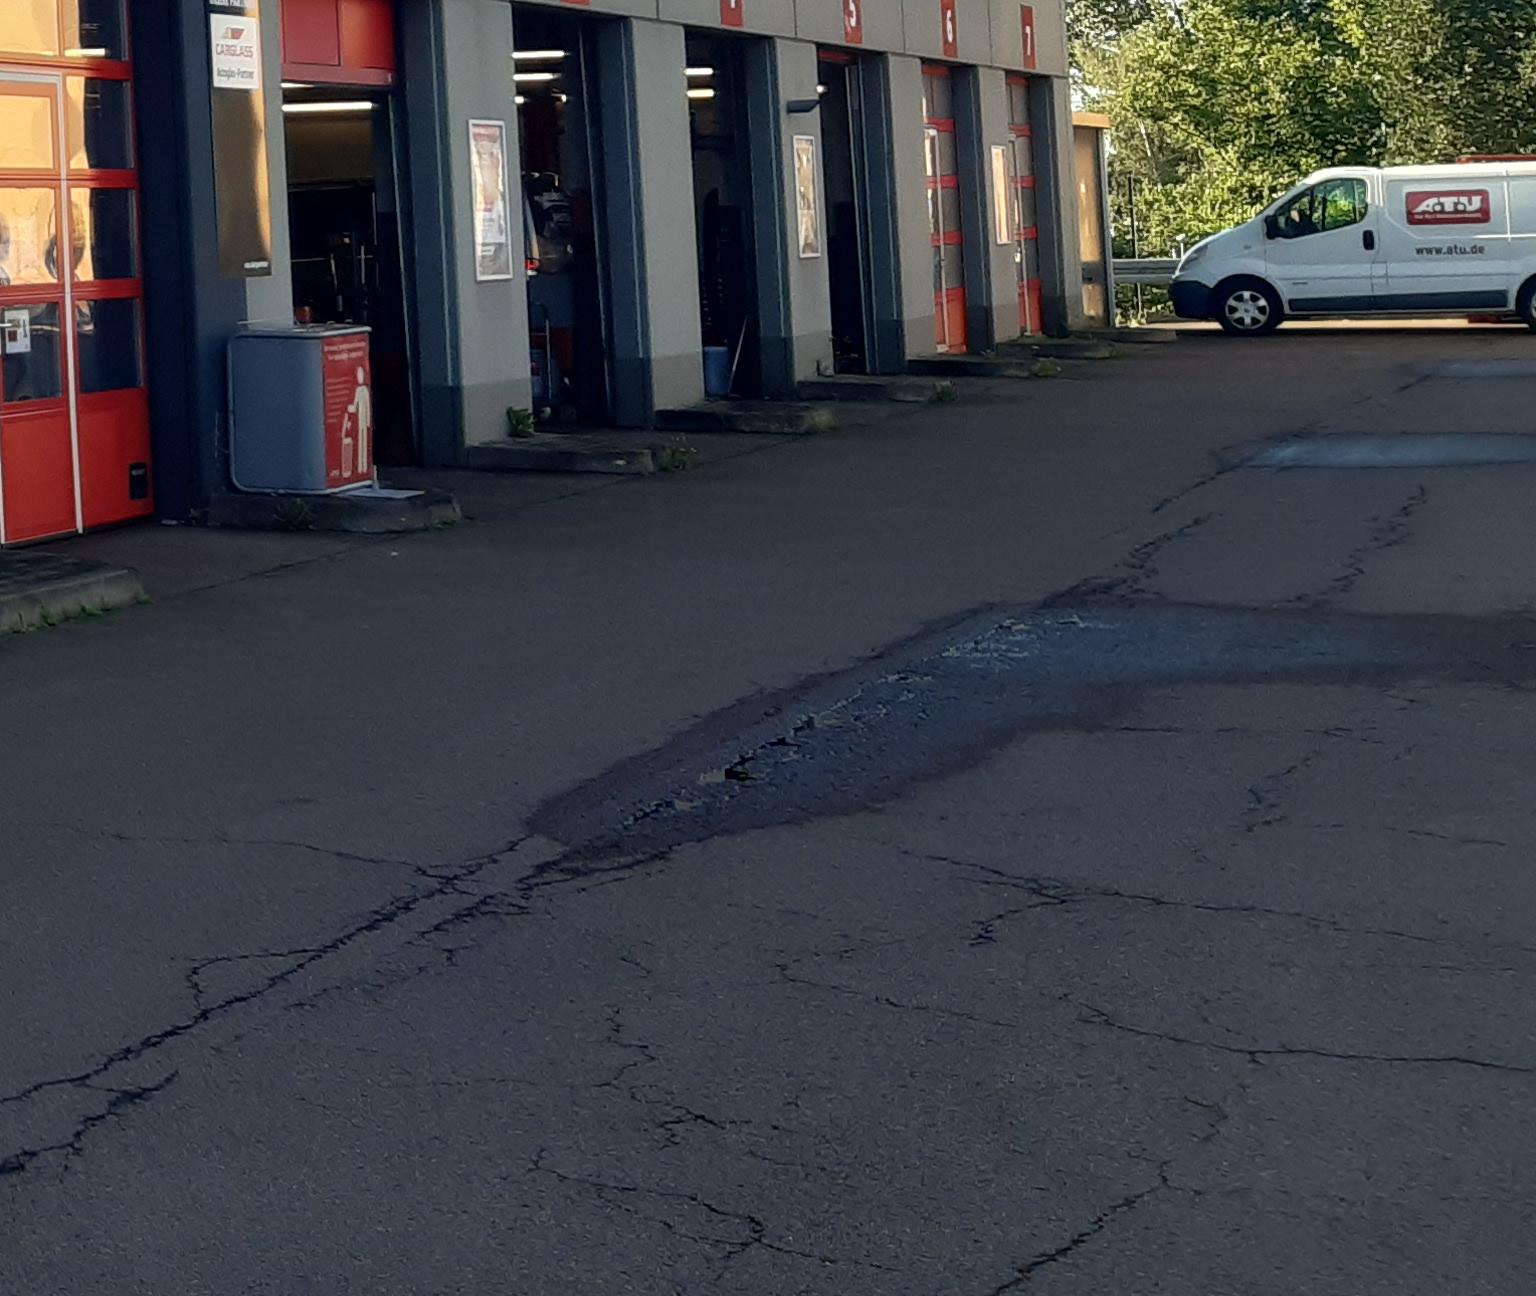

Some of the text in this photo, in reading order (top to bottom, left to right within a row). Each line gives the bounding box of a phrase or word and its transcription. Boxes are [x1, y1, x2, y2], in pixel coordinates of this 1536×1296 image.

[944, 8, 954, 43] 6
[1023, 25, 1032, 56] 7
[1414, 244, 1485, 256] www.atu.de
